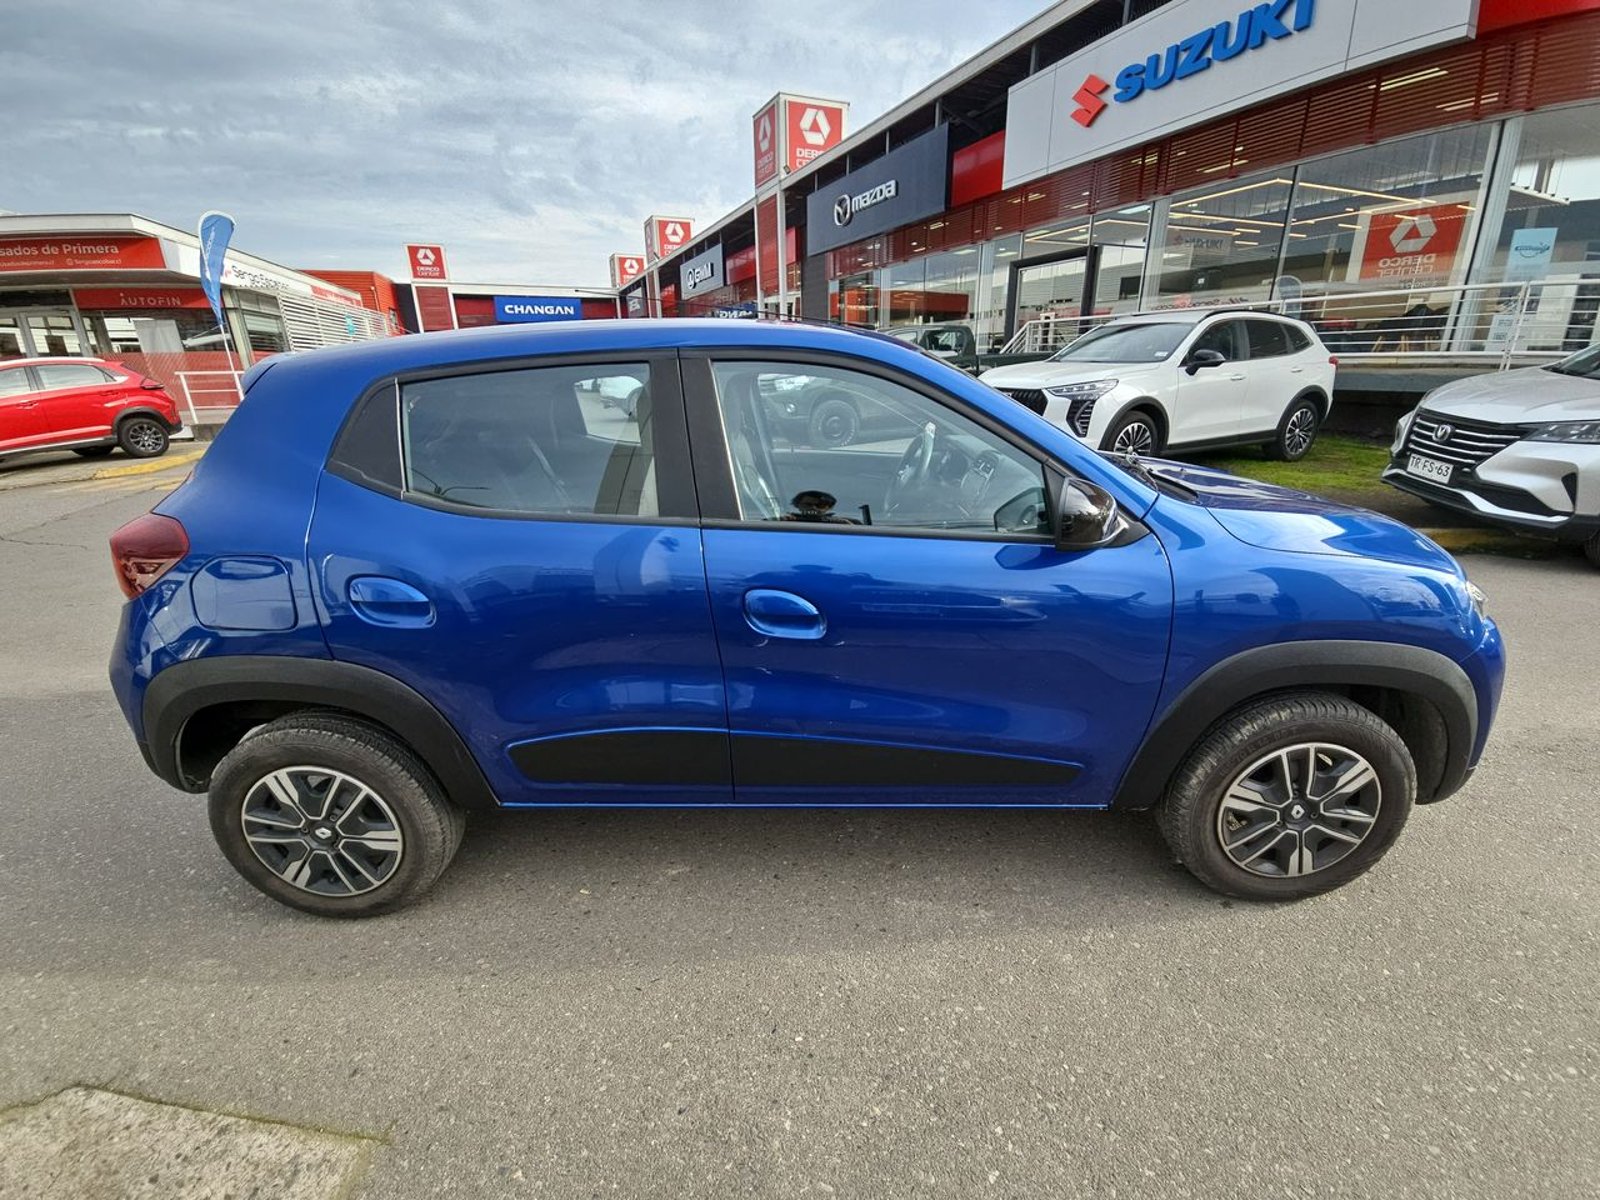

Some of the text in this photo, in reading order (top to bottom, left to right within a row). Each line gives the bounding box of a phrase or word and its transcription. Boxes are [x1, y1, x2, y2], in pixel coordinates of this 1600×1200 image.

[1113, 0, 1315, 102] SUZUKI
[796, 148, 825, 158] DER
[851, 179, 897, 213] mazda
[41, 244, 59, 255] de
[62, 243, 119, 254] Primera
[120, 293, 181, 306] AUTOFIN
[504, 304, 575, 315] CHANGAN
